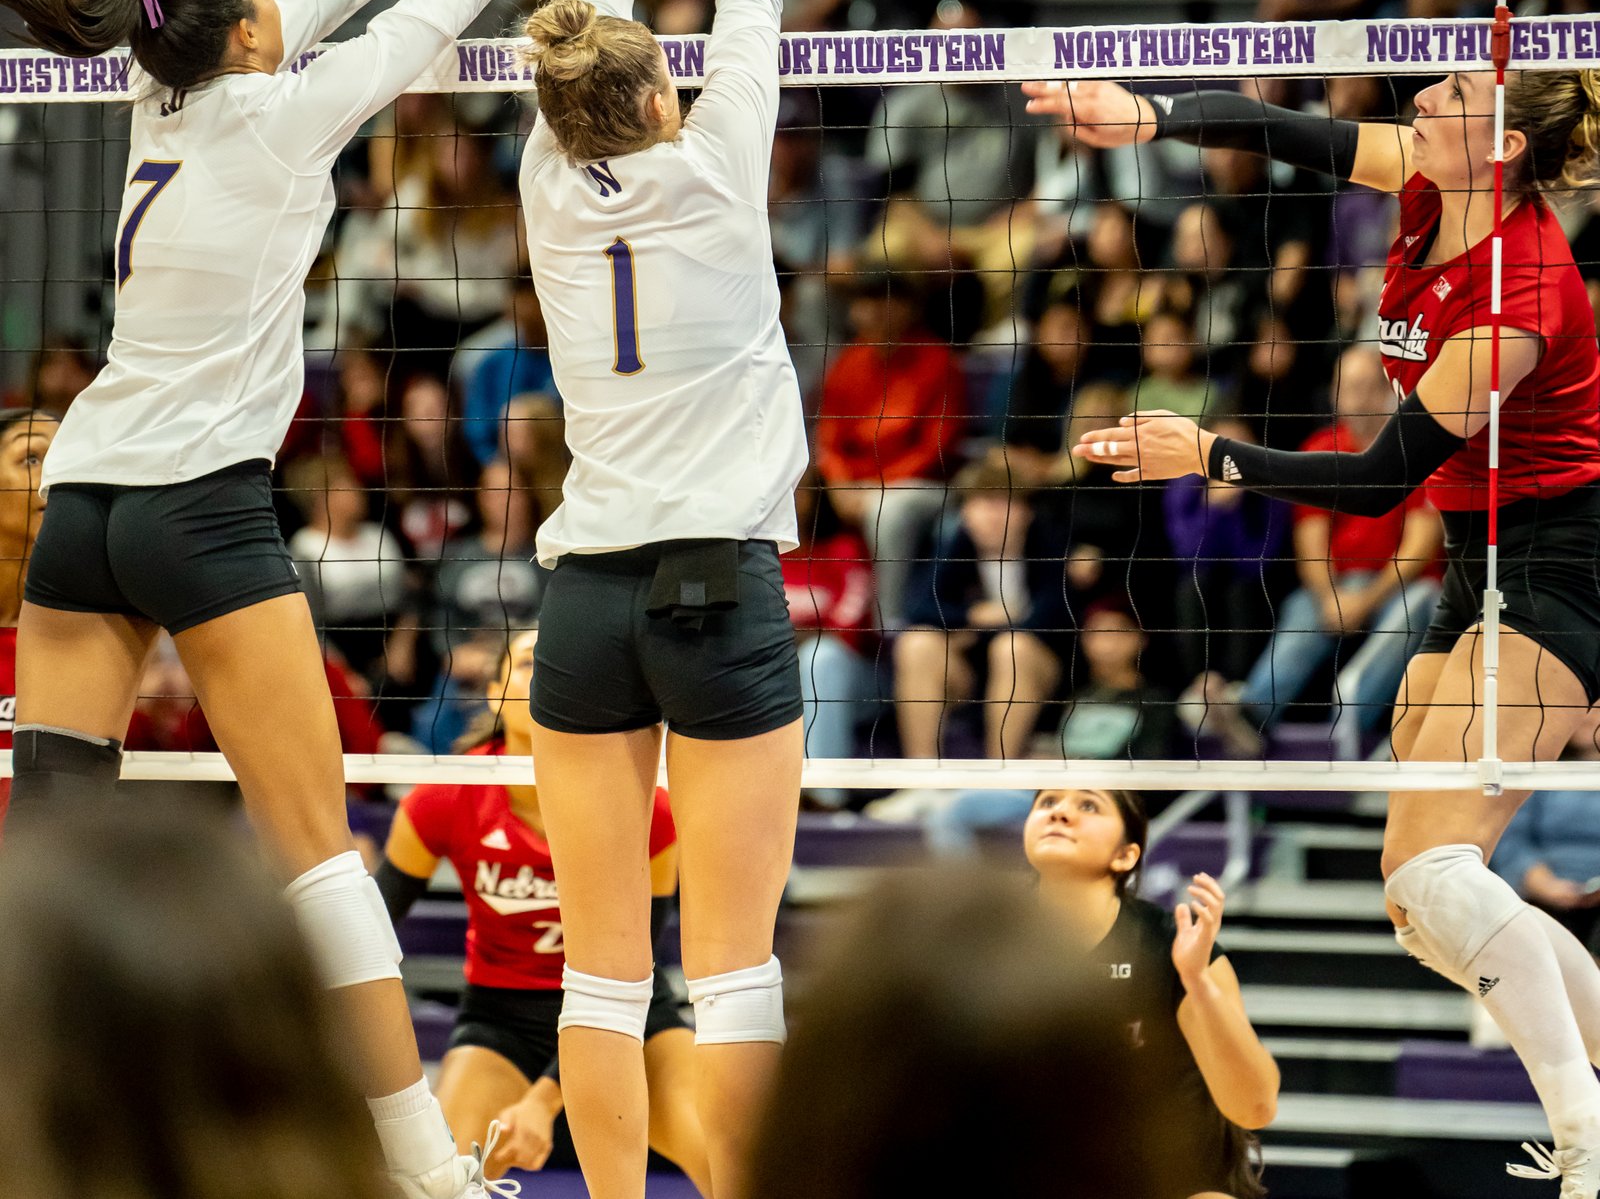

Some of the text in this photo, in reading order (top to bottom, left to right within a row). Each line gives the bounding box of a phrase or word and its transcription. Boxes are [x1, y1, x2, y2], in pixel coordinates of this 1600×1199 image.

[1053, 26, 1316, 69] NORTHWESTERN
[118, 159, 184, 294] 7
[602, 235, 646, 377] 1
